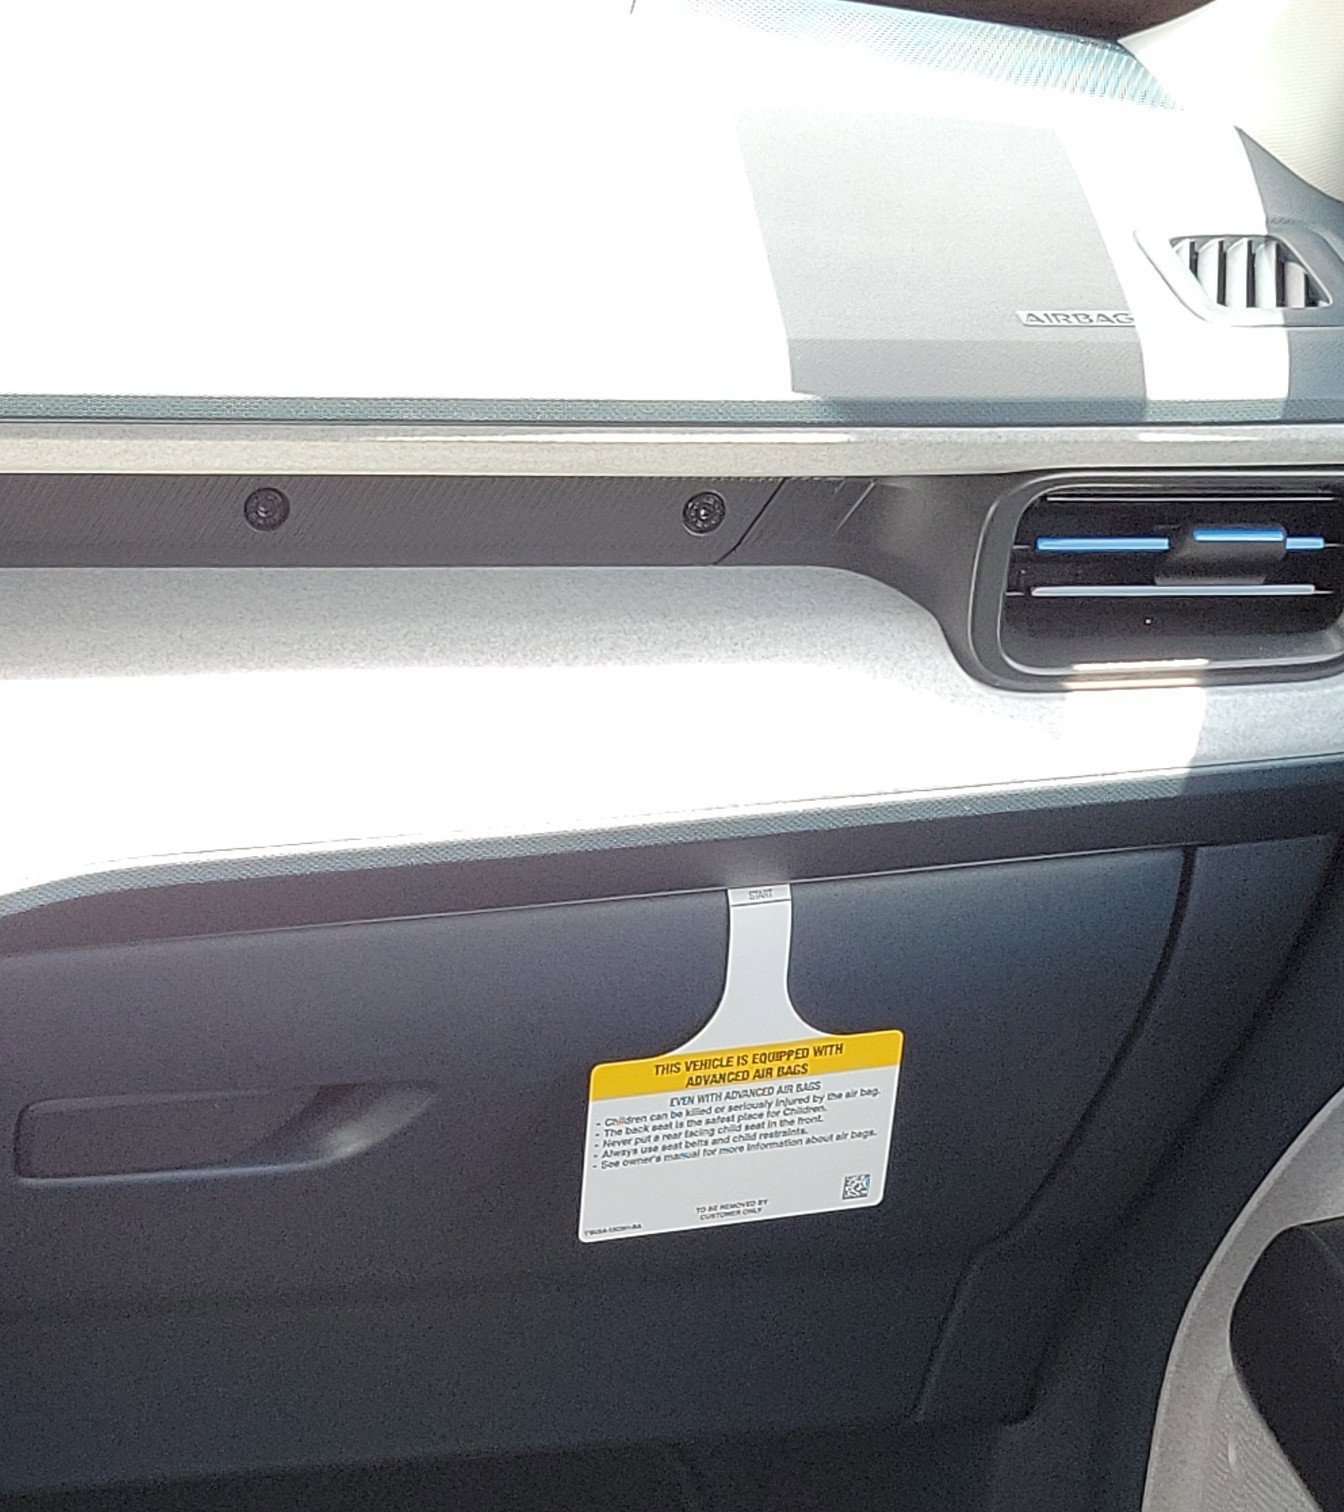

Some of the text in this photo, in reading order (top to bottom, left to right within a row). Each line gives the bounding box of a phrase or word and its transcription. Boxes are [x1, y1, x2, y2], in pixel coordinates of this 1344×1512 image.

[1026, 312, 1135, 324] AIRBAG
[654, 1042, 844, 1077] THIS VEHICLE IS EQUIPPED WITH
[685, 1062, 810, 1089] ADVANCED AIR BAGS
[669, 1080, 823, 1108] EVEN WITH ADVANCED AIR BAGS
